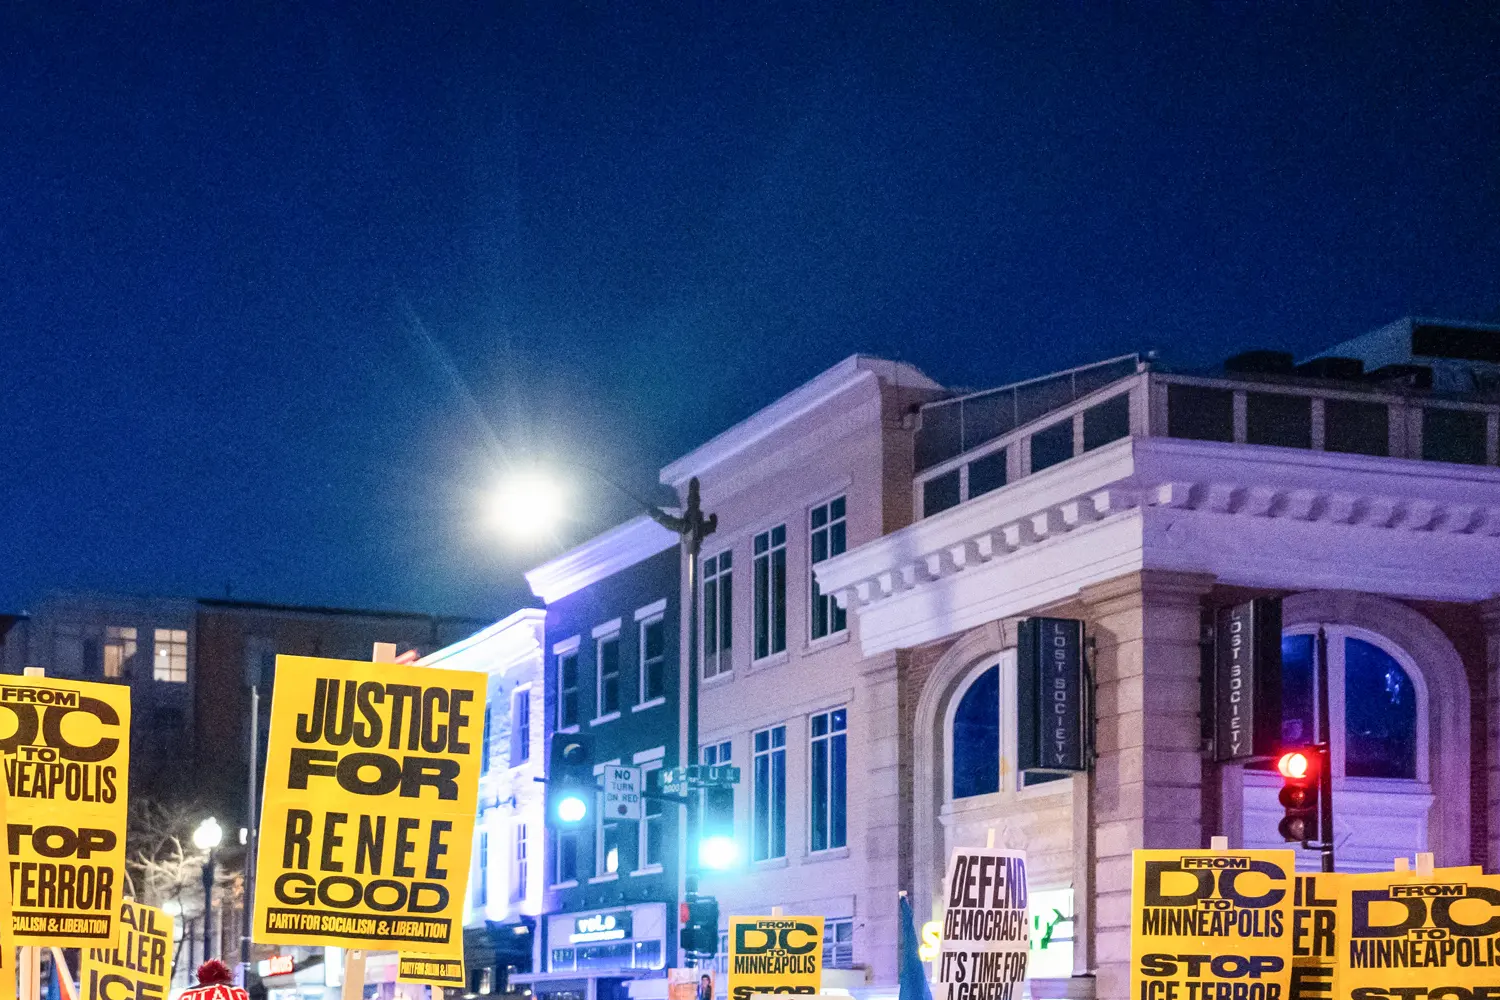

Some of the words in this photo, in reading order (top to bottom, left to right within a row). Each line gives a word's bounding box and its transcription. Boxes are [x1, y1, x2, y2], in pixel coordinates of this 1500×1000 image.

[1054, 624, 1066, 672] LOST
[1231, 610, 1242, 660] LOST
[2, 688, 76, 706] FROM
[1231, 665, 1242, 755] SOCIETY
[296, 678, 474, 754] JUSTICE
[1054, 679, 1066, 764] SOCIETY
[21, 748, 57, 762] TO
[4, 758, 116, 804] NEAPOLIS
[287, 748, 460, 800] FOR
[612, 782, 634, 791] TURN
[614, 769, 630, 779] NO
[622, 793, 638, 802] RED
[7, 823, 117, 859] TOP
[282, 808, 453, 880] RENEE
[1183, 858, 1248, 869] FROM
[274, 872, 450, 914] GOOD
[949, 855, 1028, 909] DEFEND
[1144, 861, 1287, 908] DC
[1294, 877, 1337, 907] IL
[1393, 885, 1463, 896] FROM
[120, 903, 167, 937] AIL
[1200, 900, 1231, 910] TO
[1352, 887, 1500, 938] DC
[12, 915, 46, 932] CIALISM
[48, 917, 59, 932] &
[60, 917, 107, 934] LIBERATION
[269, 912, 300, 929] PARTY
[301, 914, 320, 931] FOR
[321, 916, 376, 935] SOCIALISM
[378, 920, 390, 935] &
[391, 920, 447, 939] LIBERATION
[736, 923, 818, 954] DC
[758, 921, 795, 929] FROM
[944, 909, 1029, 941] DEMOCRACY:
[1142, 908, 1284, 938] MINNEAPOLIS
[1411, 929, 1447, 939] TO
[734, 955, 816, 975] MINNEAPOLIS
[940, 951, 967, 983] IT'S
[971, 952, 1003, 983] TIME
[1003, 952, 1027, 983] FOR
[1140, 953, 1284, 979] STOP
